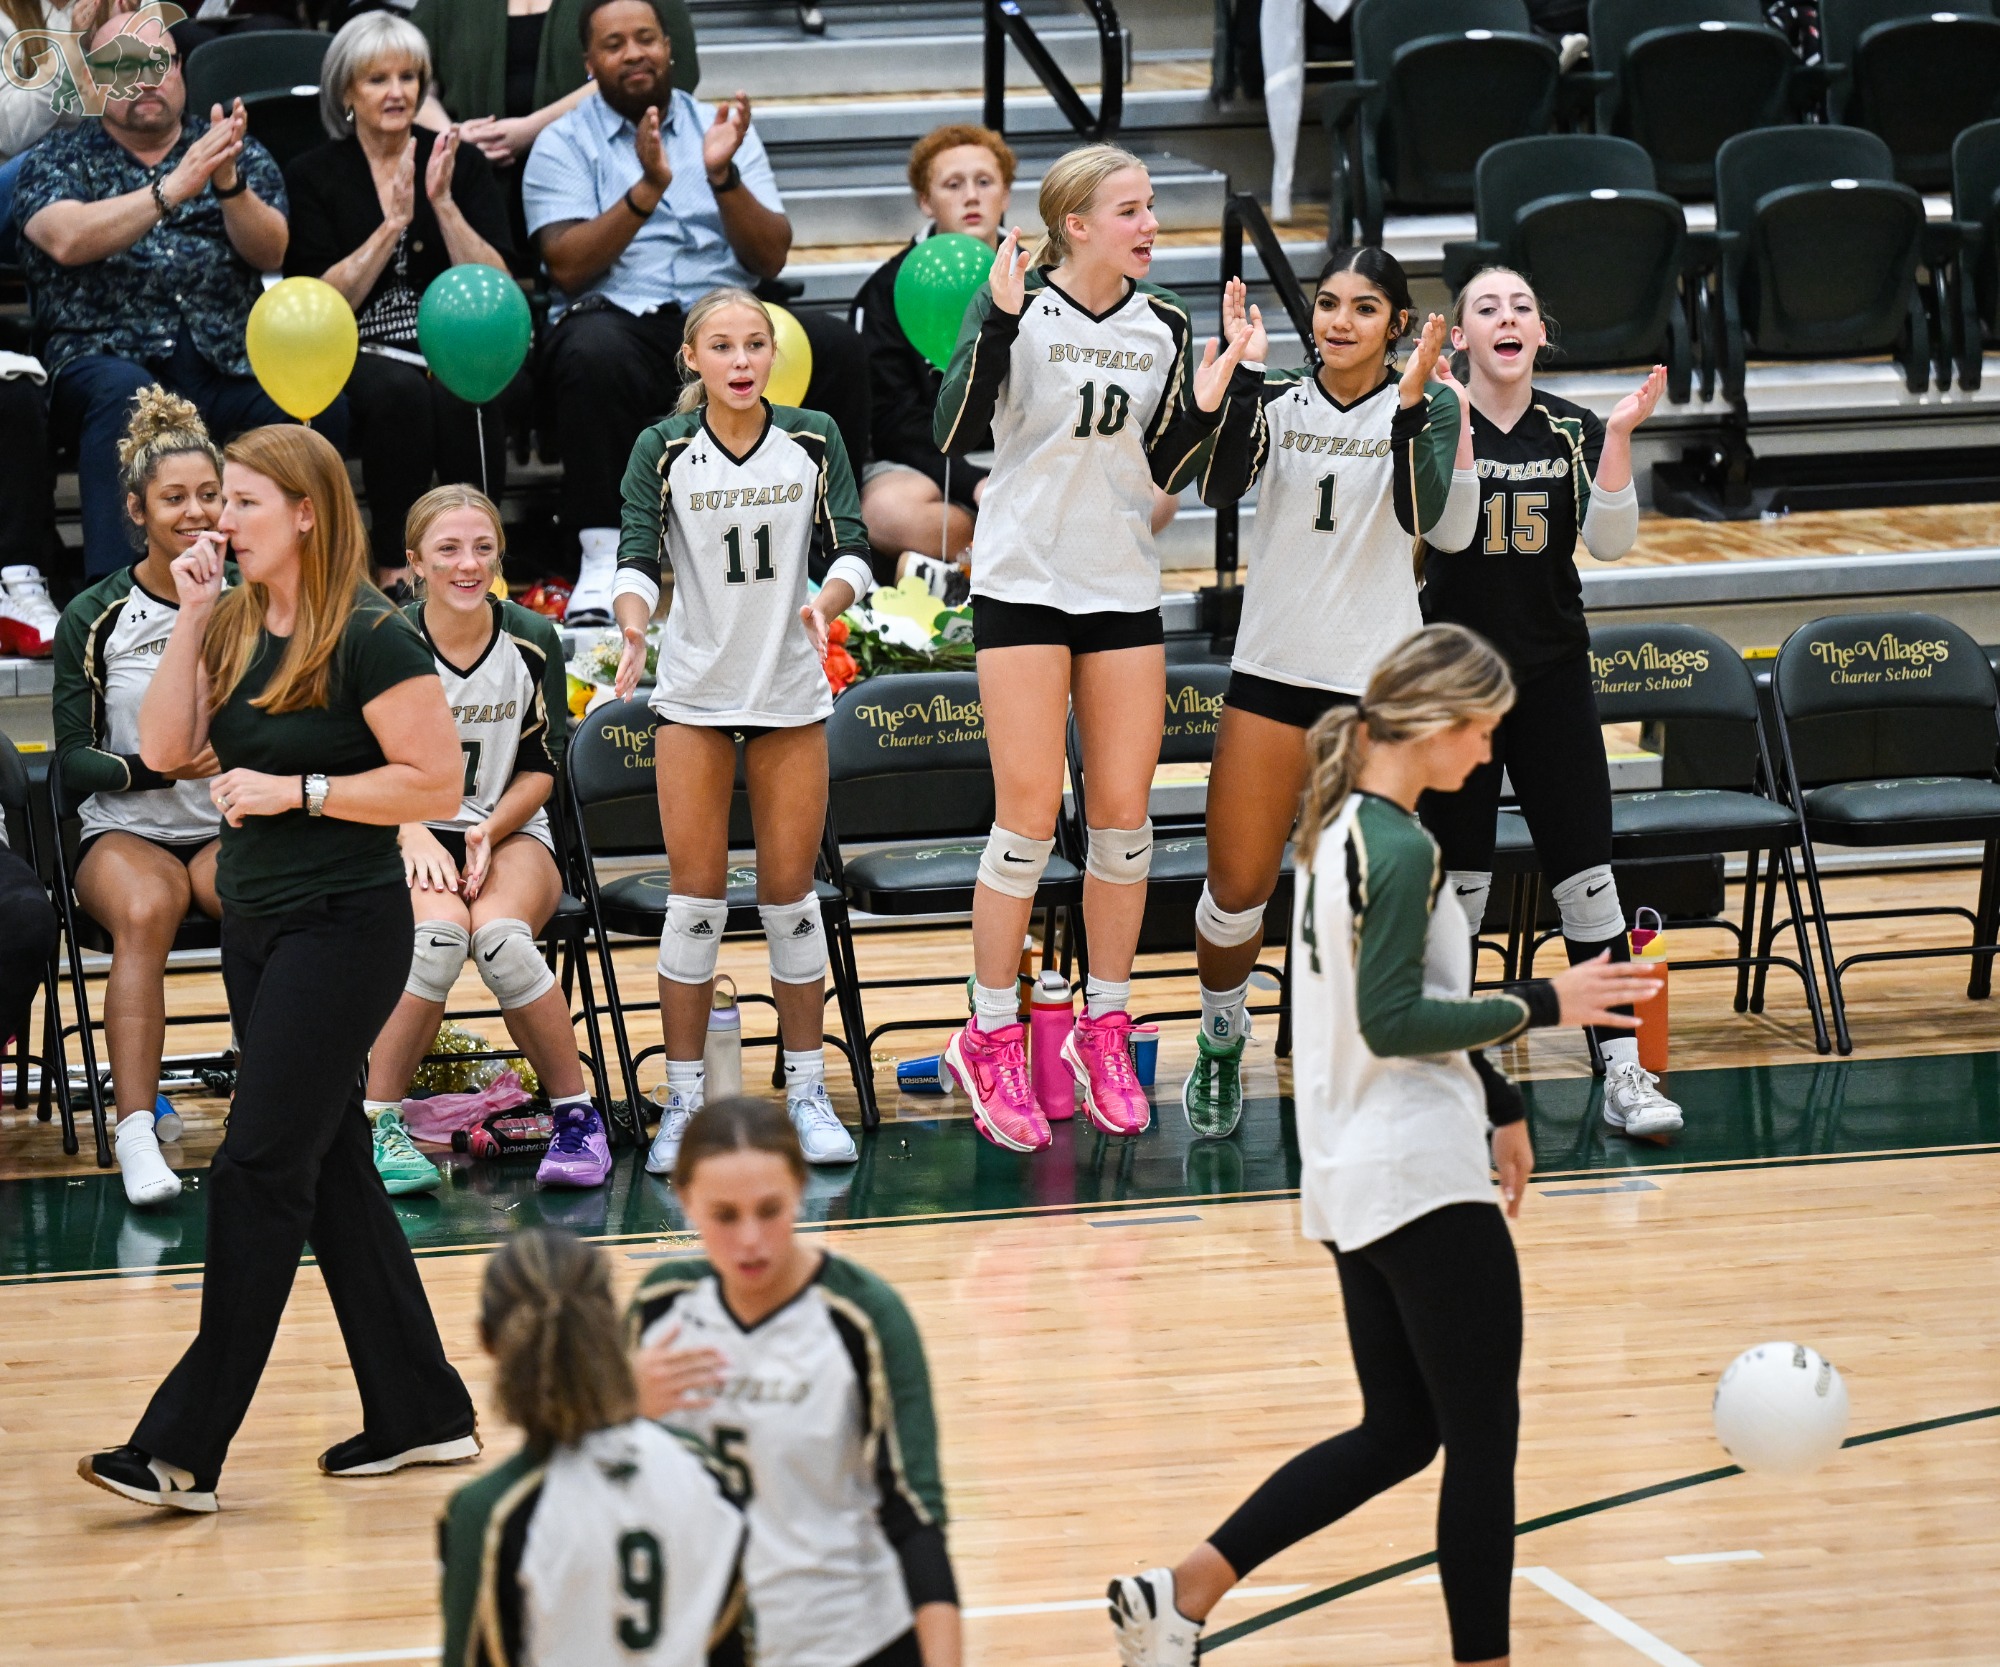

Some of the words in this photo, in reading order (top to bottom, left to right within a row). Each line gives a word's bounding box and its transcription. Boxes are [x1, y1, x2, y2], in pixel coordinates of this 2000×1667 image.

[1048, 343, 1154, 372] BUFFALO
[1071, 378, 1131, 439] 10
[1279, 429, 1392, 458] BUFFALO
[1475, 457, 1569, 481] UFFALO
[689, 482, 803, 511] BUFFALO
[1312, 470, 1338, 534] 1
[1483, 491, 1549, 555] 15
[721, 521, 777, 586] 11
[1587, 650, 1615, 678] he
[1614, 642, 1709, 675] Villages
[1809, 641, 1855, 668] The
[1854, 633, 1949, 665] Villages
[1645, 673, 1693, 691] School
[1830, 667, 1881, 684] Charter
[1885, 664, 1933, 681] School
[855, 705, 905, 732] The
[903, 694, 984, 726] Village
[1166, 685, 1225, 719] Villag
[601, 724, 649, 752] The
[878, 733, 934, 748] Charter
[937, 728, 986, 744] School
[1185, 720, 1218, 735] Scho
[689, 927, 714, 935] adidas
[616, 1526, 664, 1652] 9
